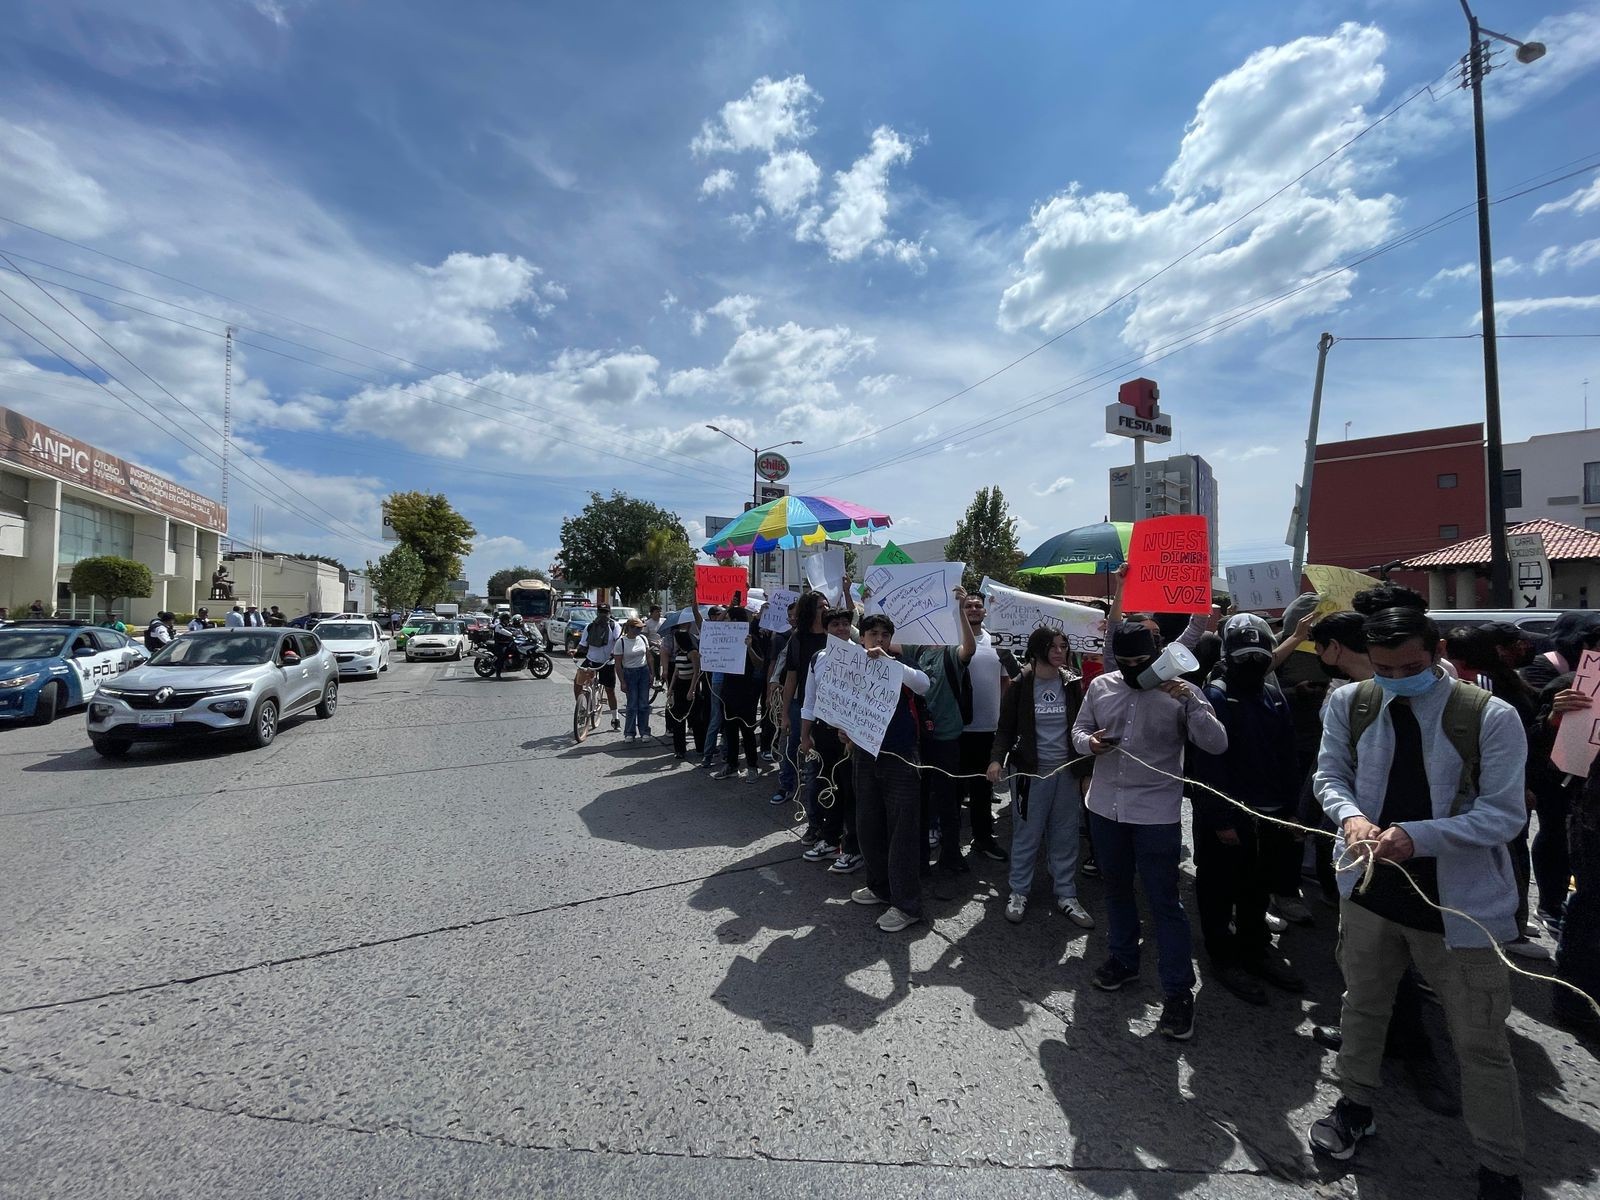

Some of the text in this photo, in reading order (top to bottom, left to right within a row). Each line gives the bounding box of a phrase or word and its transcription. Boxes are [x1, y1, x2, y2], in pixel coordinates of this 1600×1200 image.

[1119, 416, 1172, 437] FIESTA INN
[30, 432, 89, 474] ANPIC
[93, 459, 120, 476] OTOÑO
[760, 458, 786, 471] chili's
[1060, 553, 1114, 562] NAUTICA
[1163, 586, 1207, 605] VOZ
[834, 647, 848, 665] SI
[850, 651, 891, 681] AHORA
